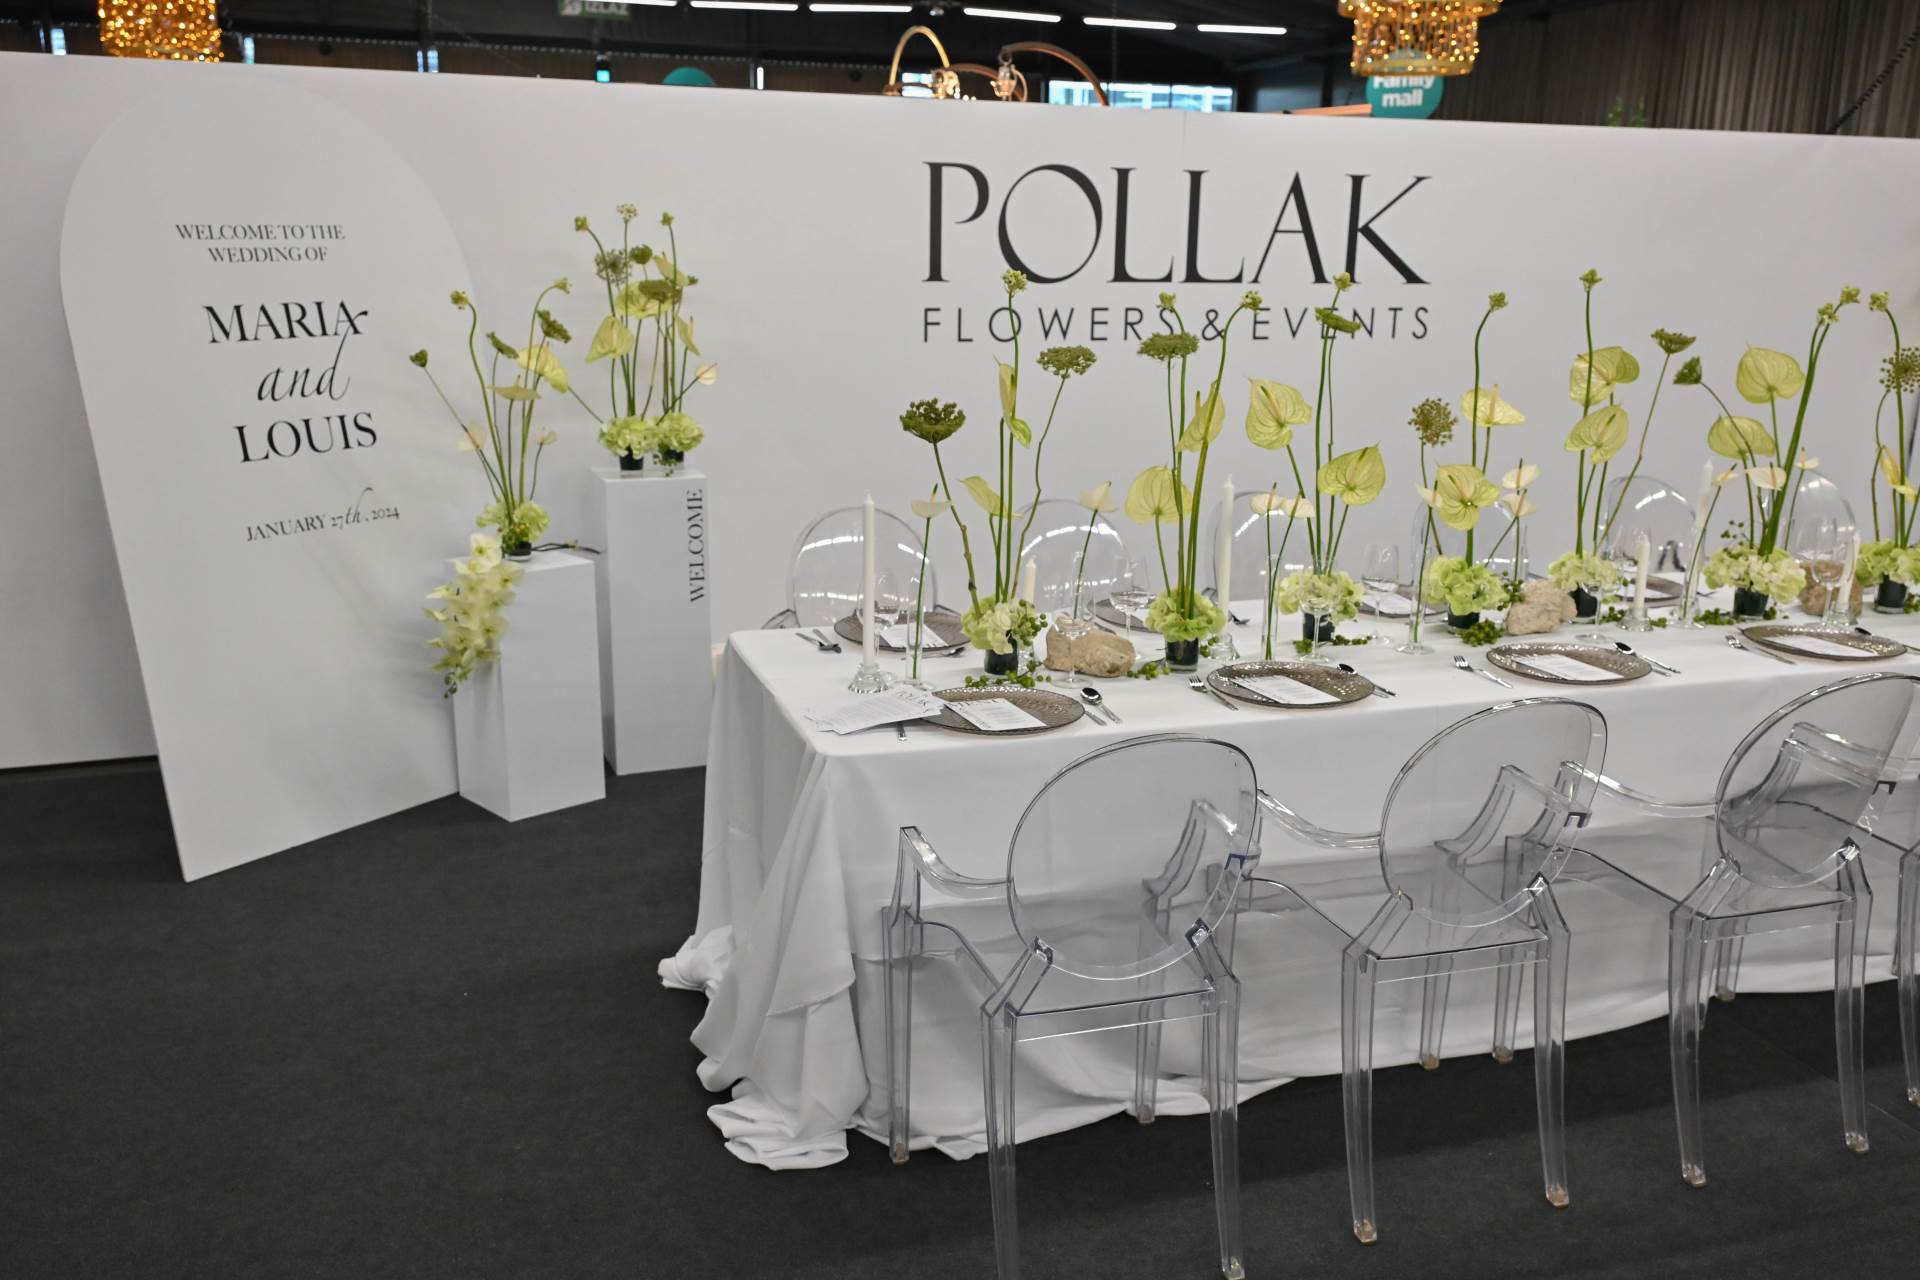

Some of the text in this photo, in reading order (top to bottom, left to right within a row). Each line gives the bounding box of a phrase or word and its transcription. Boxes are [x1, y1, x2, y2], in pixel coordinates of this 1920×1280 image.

[1382, 88, 1424, 107] mall
[175, 224, 345, 240] WELCOME TO THE
[921, 161, 1432, 284] POLLAK
[208, 247, 328, 263] WEDDING OF
[202, 300, 363, 344] MARIA
[923, 307, 1176, 343] FLOWERS
[1201, 309, 1226, 341] &
[257, 309, 369, 402] and
[233, 411, 377, 464] LOUIS
[247, 513, 326, 542] JANUARY
[371, 506, 401, 521] 2024
[687, 488, 705, 602] WELCOME
